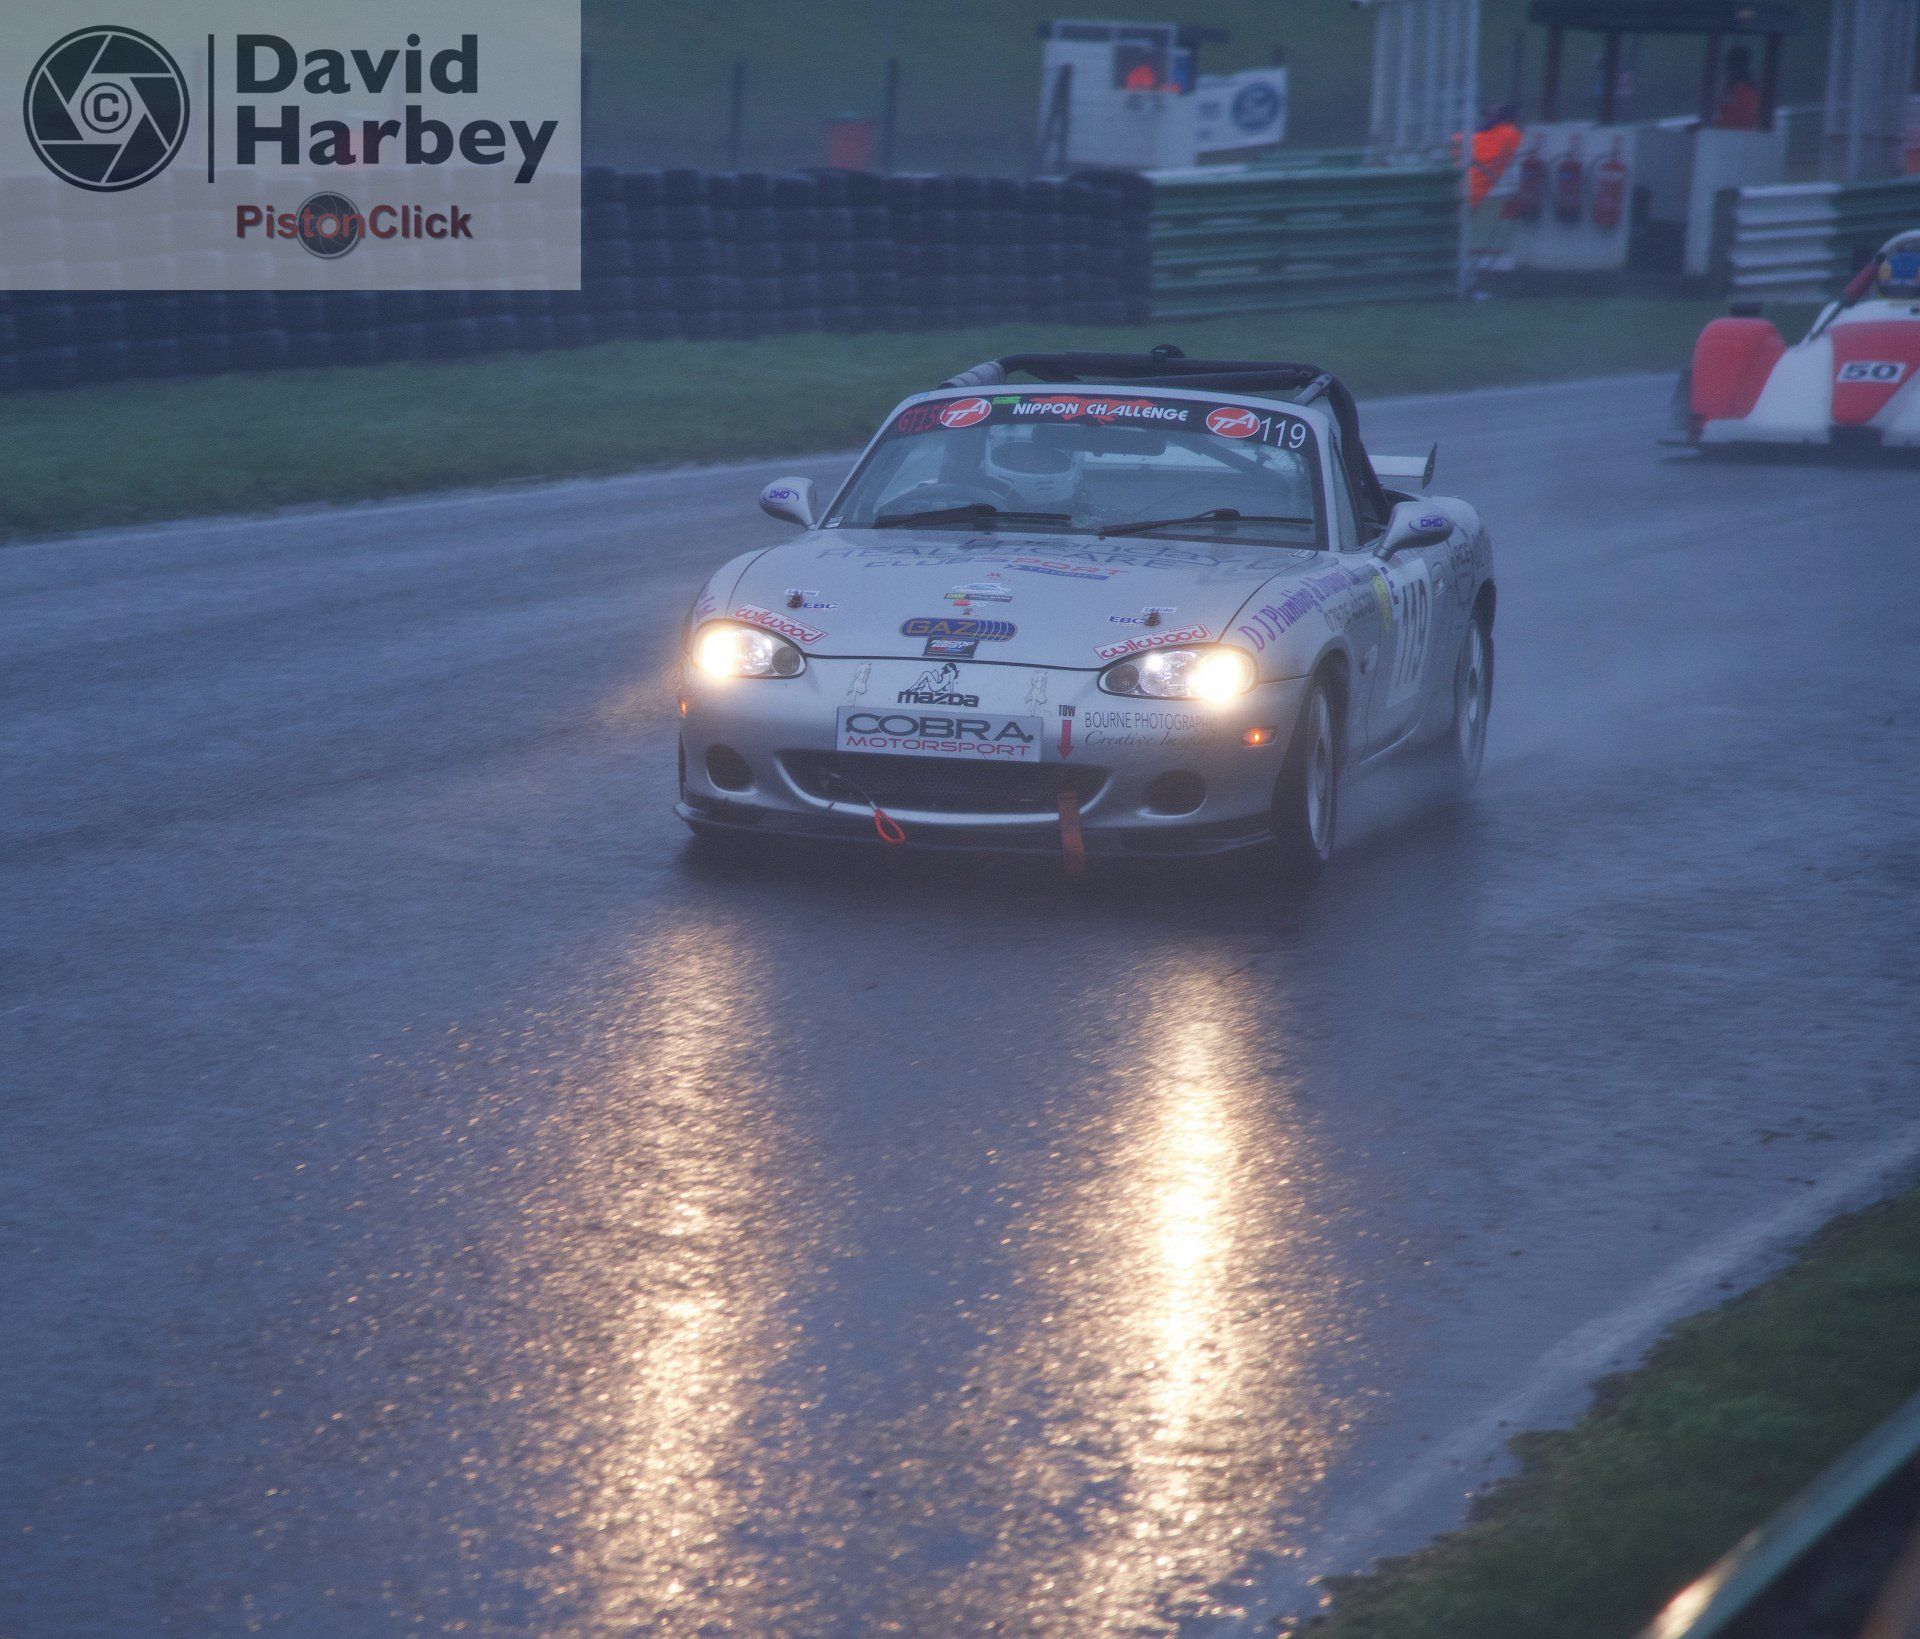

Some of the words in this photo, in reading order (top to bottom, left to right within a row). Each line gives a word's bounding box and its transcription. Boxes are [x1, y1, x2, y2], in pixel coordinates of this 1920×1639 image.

[1843, 364, 1898, 379] 50
[1013, 402, 1078, 415] NIPPON
[1086, 403, 1189, 421] CHALLENGE
[1260, 417, 1306, 449] 119
[735, 608, 824, 643] wilwood
[906, 620, 978, 635] GAZ
[1108, 615, 1146, 625] EBC
[1101, 624, 1209, 659] wilwood
[1238, 625, 1265, 653] D
[1252, 615, 1276, 641] J
[1058, 704, 1076, 717] TOW
[846, 713, 1034, 742] COBRA
[1085, 712, 1132, 729] BOURNE
[847, 736, 1030, 756] MOTORSPORT
[1085, 731, 1151, 746] Creative
